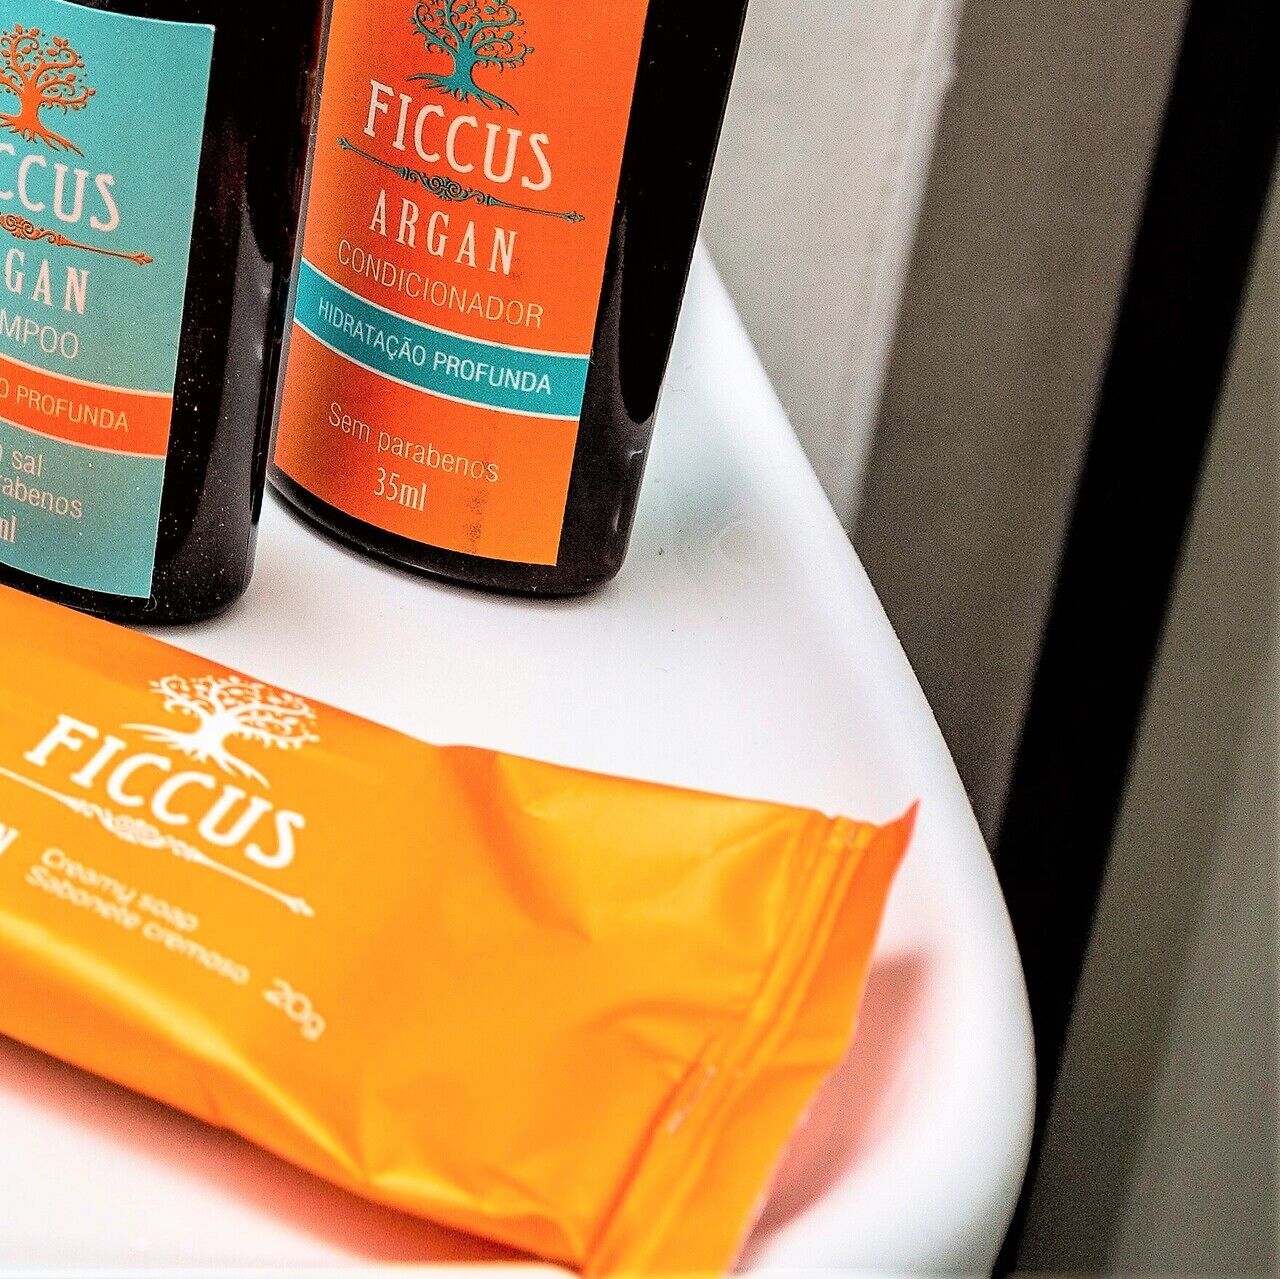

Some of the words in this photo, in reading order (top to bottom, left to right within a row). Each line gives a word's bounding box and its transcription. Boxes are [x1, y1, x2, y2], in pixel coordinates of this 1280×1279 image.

[363, 79, 552, 191] FICCUS
[369, 189, 518, 276] ARGAN
[338, 239, 545, 330] CONDICIONADOR
[318, 297, 427, 368] HIDRATAÇÃO
[433, 351, 552, 395] PROFUNDA
[16, 385, 130, 433] PROFUNDA
[328, 402, 370, 443] Sem
[377, 430, 500, 483] parabenos
[11, 450, 44, 477] sal
[373, 467, 428, 512] 35ml
[24, 713, 306, 869] FICCUS
[25, 866, 142, 930] Sabonete
[143, 921, 251, 984] cremoso
[40, 847, 137, 908] Creamy
[139, 892, 199, 932] soap
[262, 978, 327, 1042] 20g
